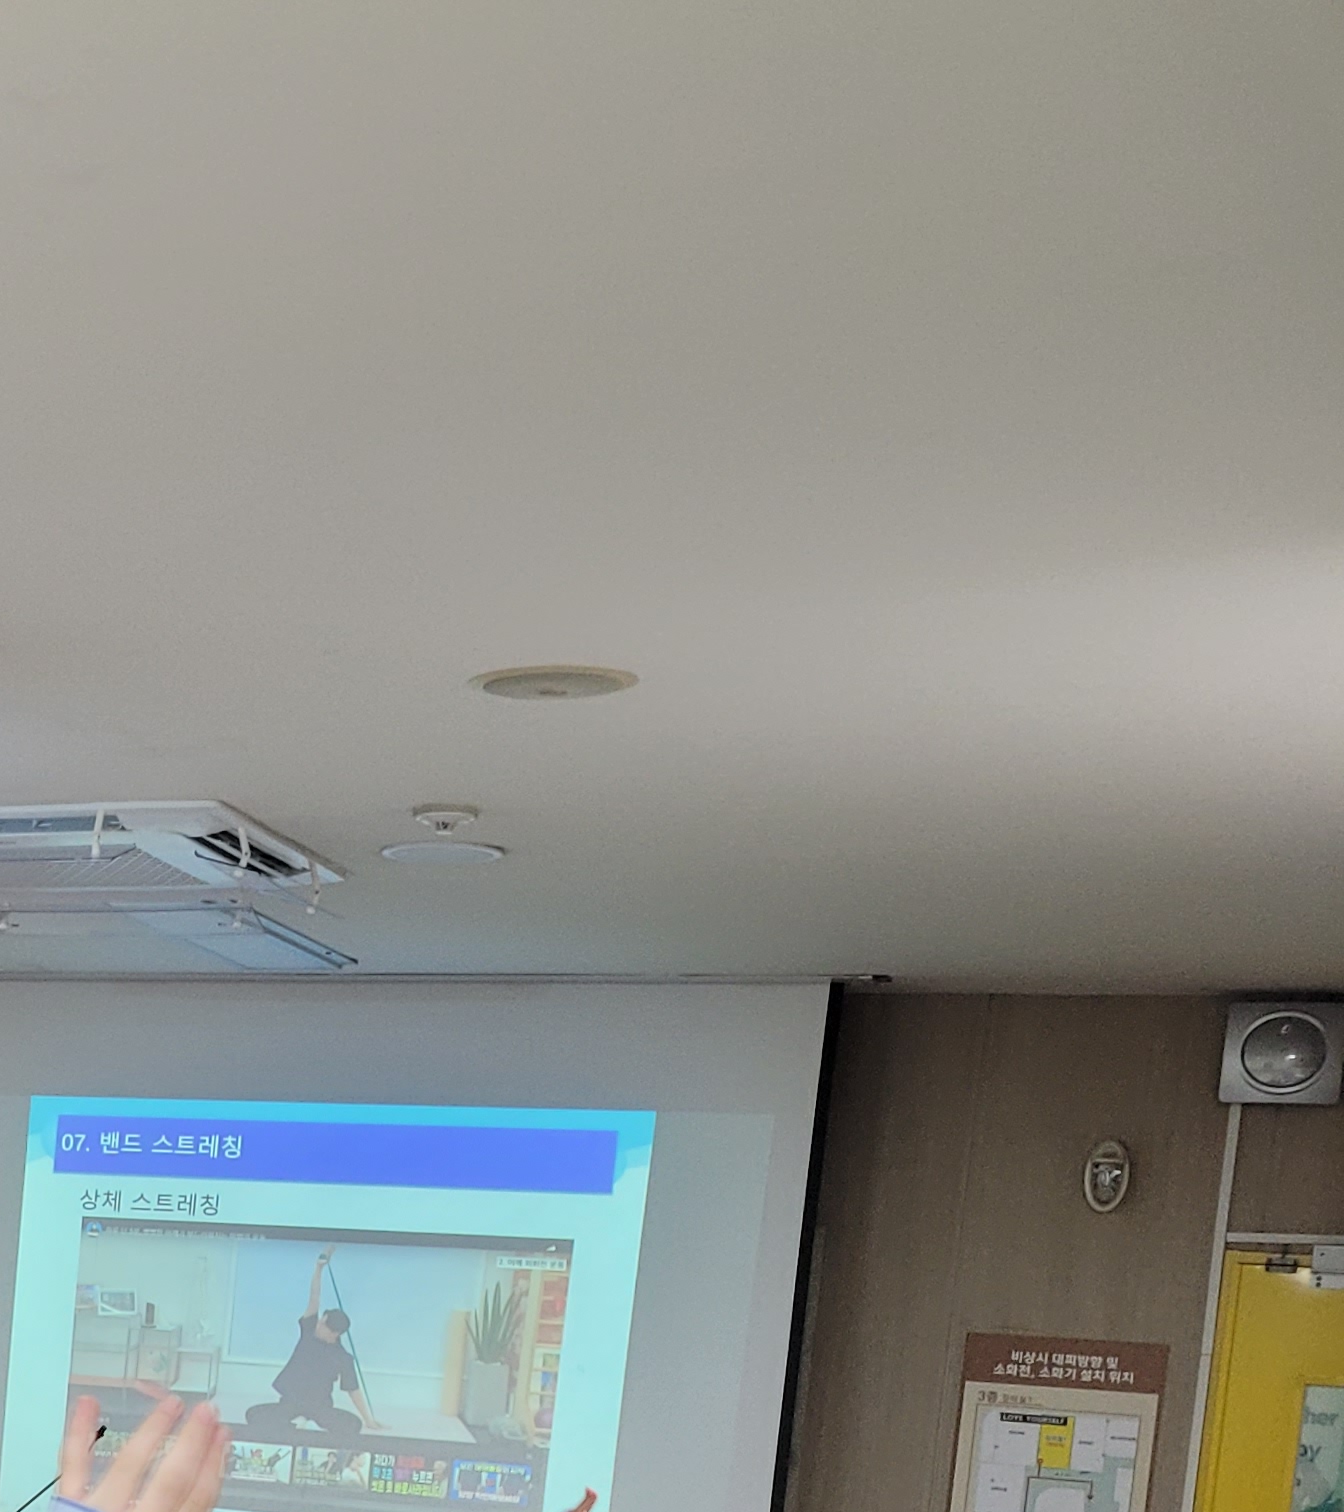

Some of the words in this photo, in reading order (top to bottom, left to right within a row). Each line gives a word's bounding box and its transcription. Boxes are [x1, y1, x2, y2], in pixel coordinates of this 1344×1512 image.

[61, 1133, 90, 1152] 07.
[100, 1131, 143, 1155] 밴드
[151, 1134, 243, 1160] 스트레칭
[79, 1188, 123, 1213] 상체
[130, 1192, 221, 1217] 스트레칭
[1011, 1349, 1049, 1365] 비상시
[1038, 1366, 1077, 1381] 소화기
[1080, 1369, 1106, 1383] 설치
